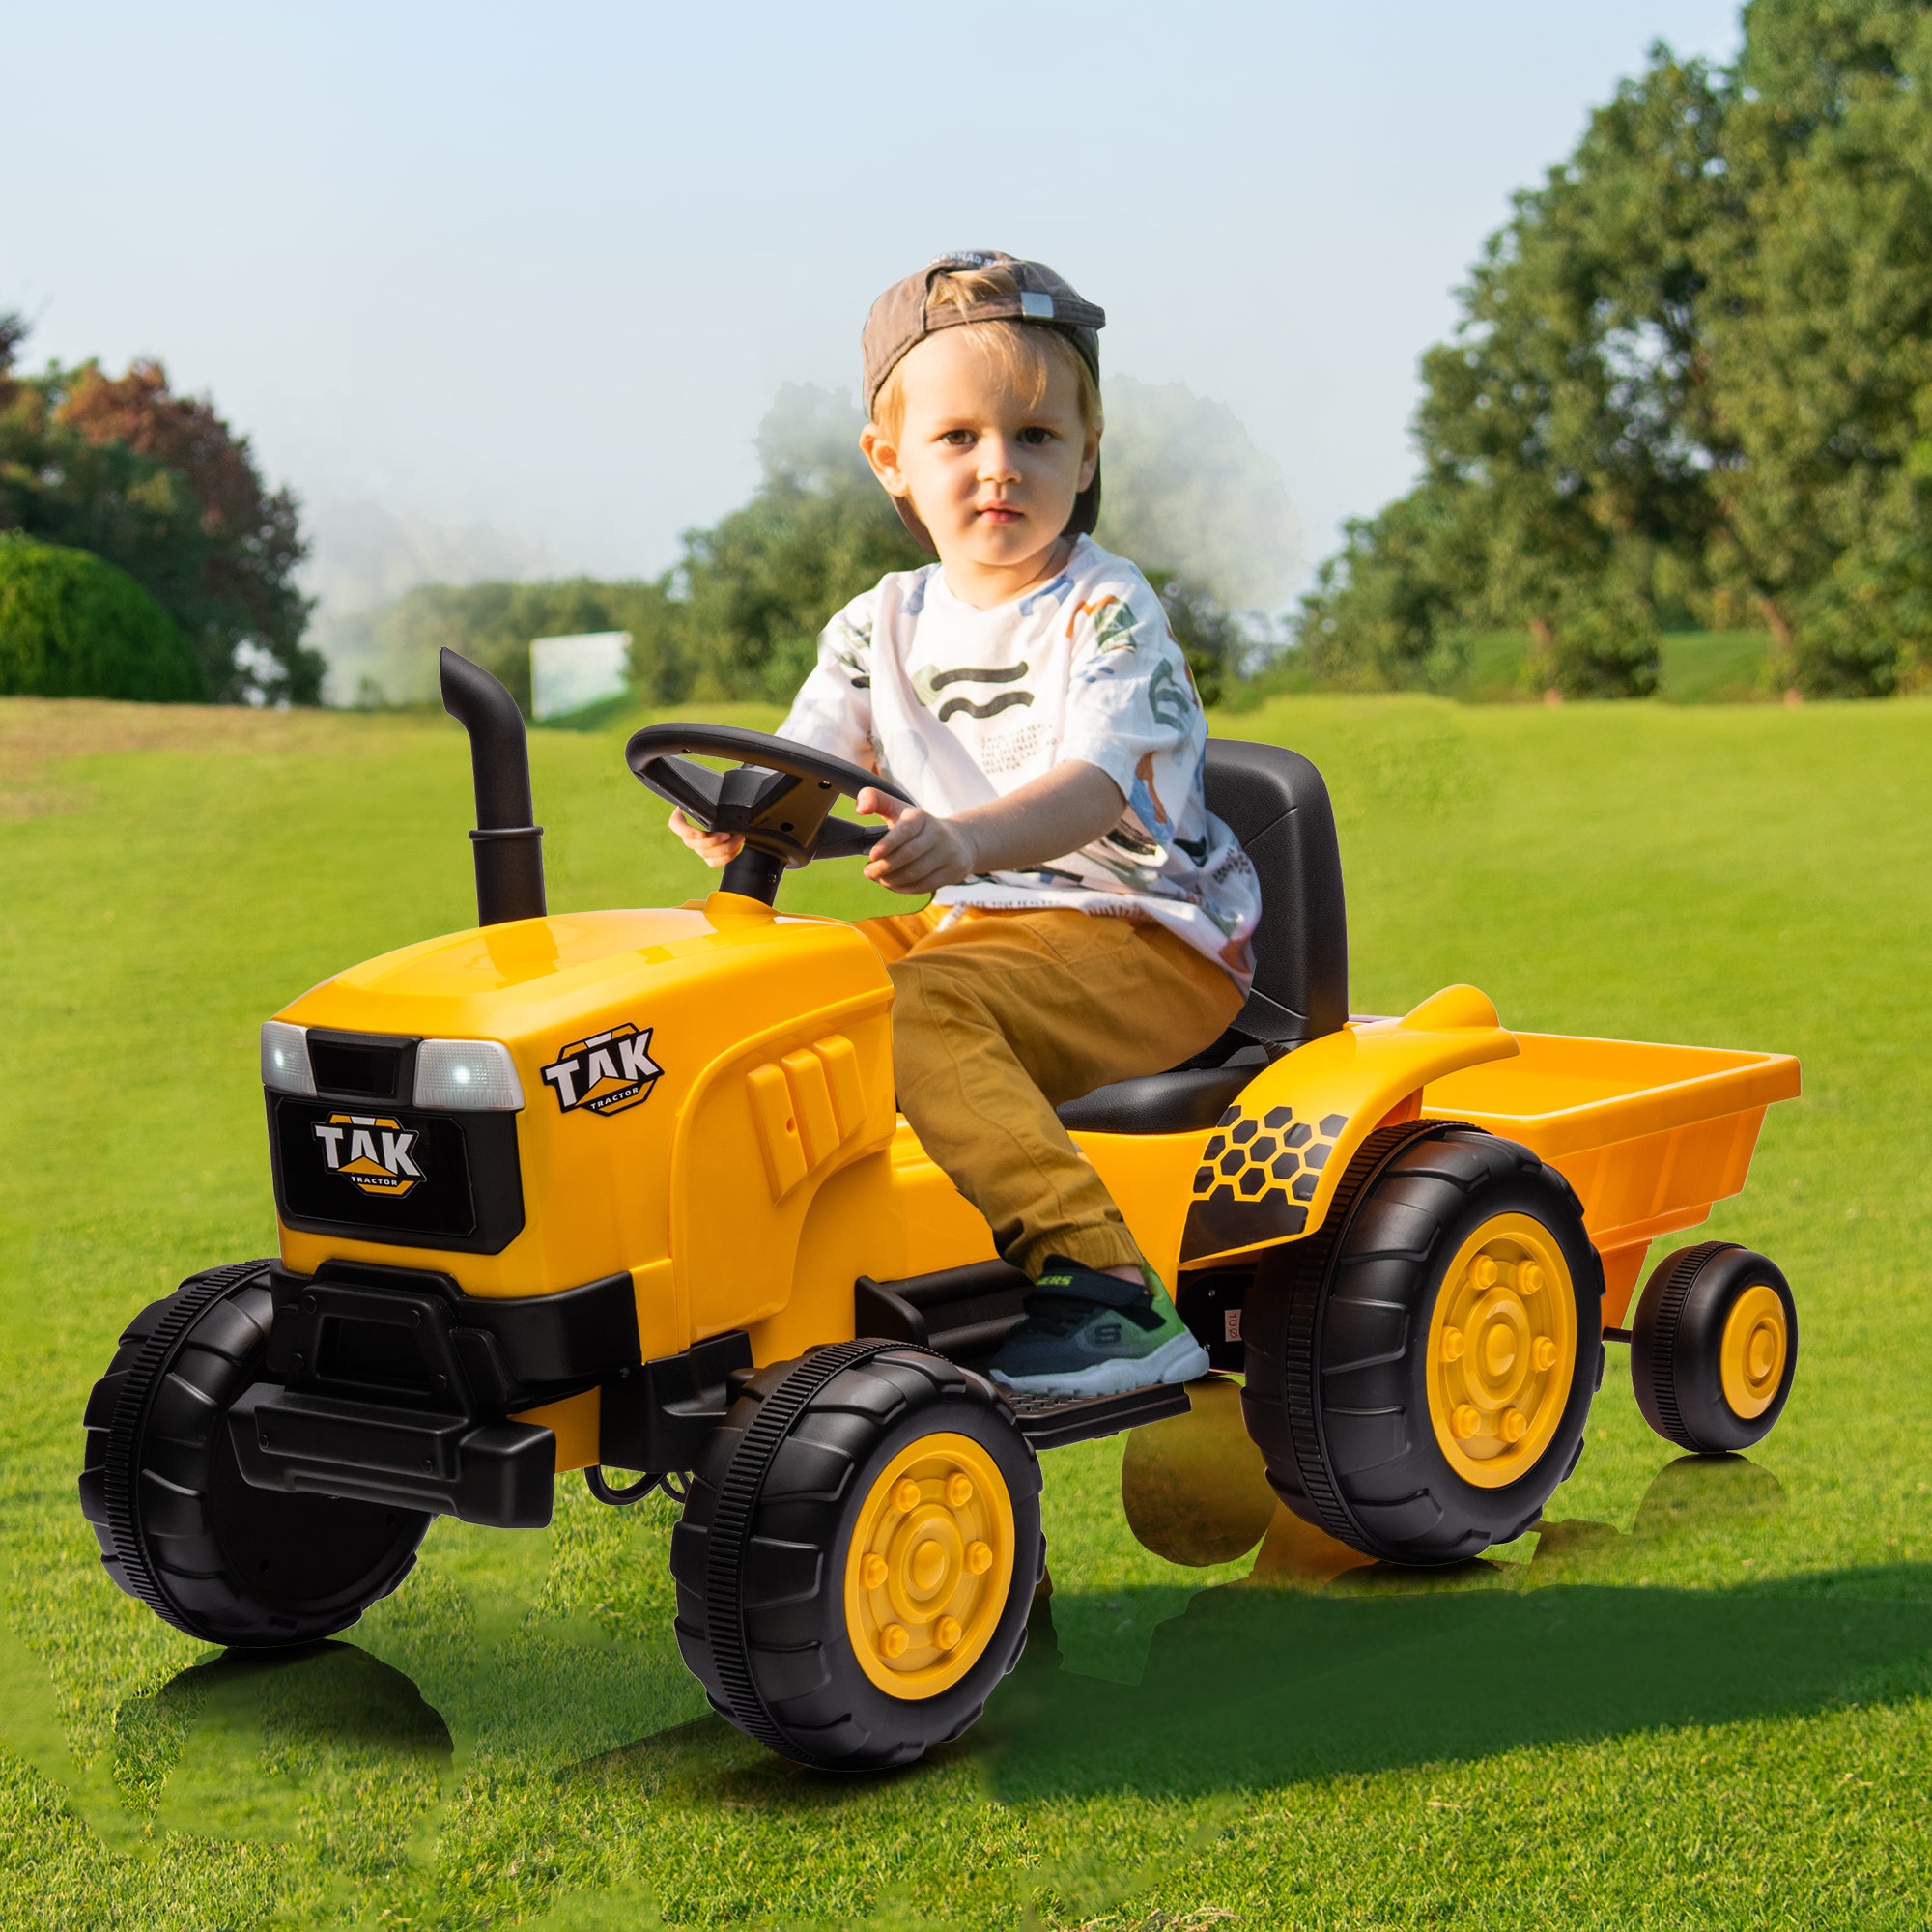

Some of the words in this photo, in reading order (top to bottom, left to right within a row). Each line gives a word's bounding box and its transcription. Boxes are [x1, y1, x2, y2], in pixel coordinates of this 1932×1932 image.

[545, 1032, 660, 1107] TAK
[590, 1087, 639, 1110] TRACTOR
[315, 1125, 421, 1177] TAK
[351, 1176, 398, 1186] TRACTOR
